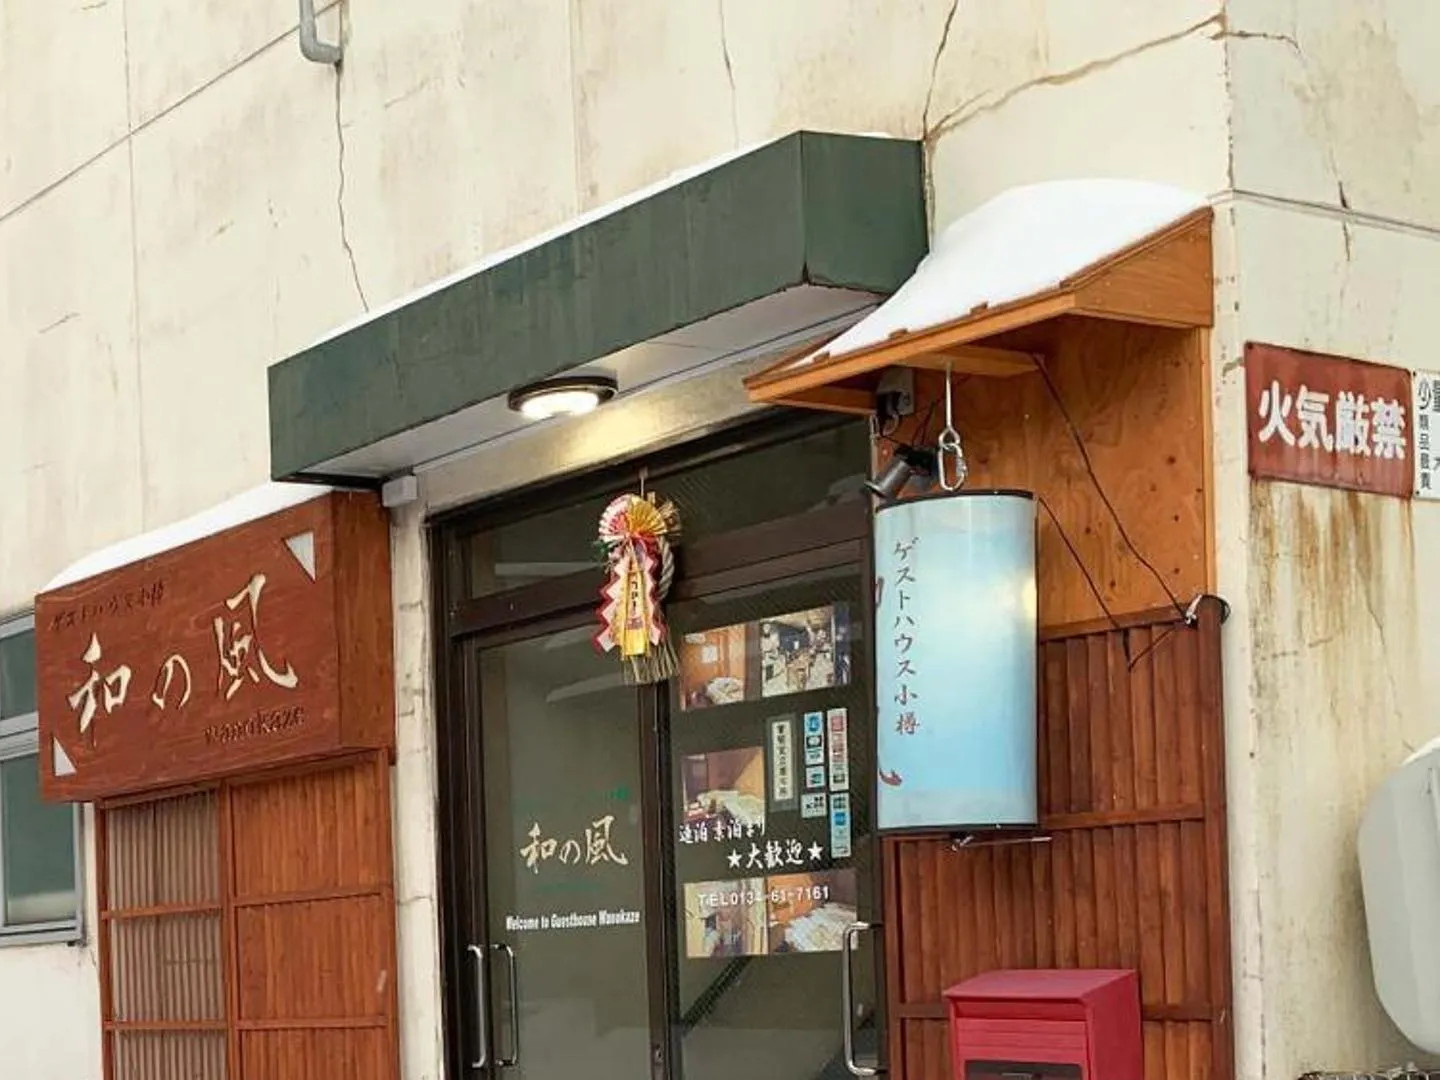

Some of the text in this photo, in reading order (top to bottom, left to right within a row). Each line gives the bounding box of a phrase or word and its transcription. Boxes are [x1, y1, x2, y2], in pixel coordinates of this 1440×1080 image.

[1258, 379, 1407, 460] 火気厳禁
[67, 573, 298, 751] 和の風
[893, 536, 920, 736] ゲストハウス小樽
[519, 814, 630, 875] 和の風
[506, 915, 539, 930] Welcome
[551, 912, 597, 928] Guesthouse
